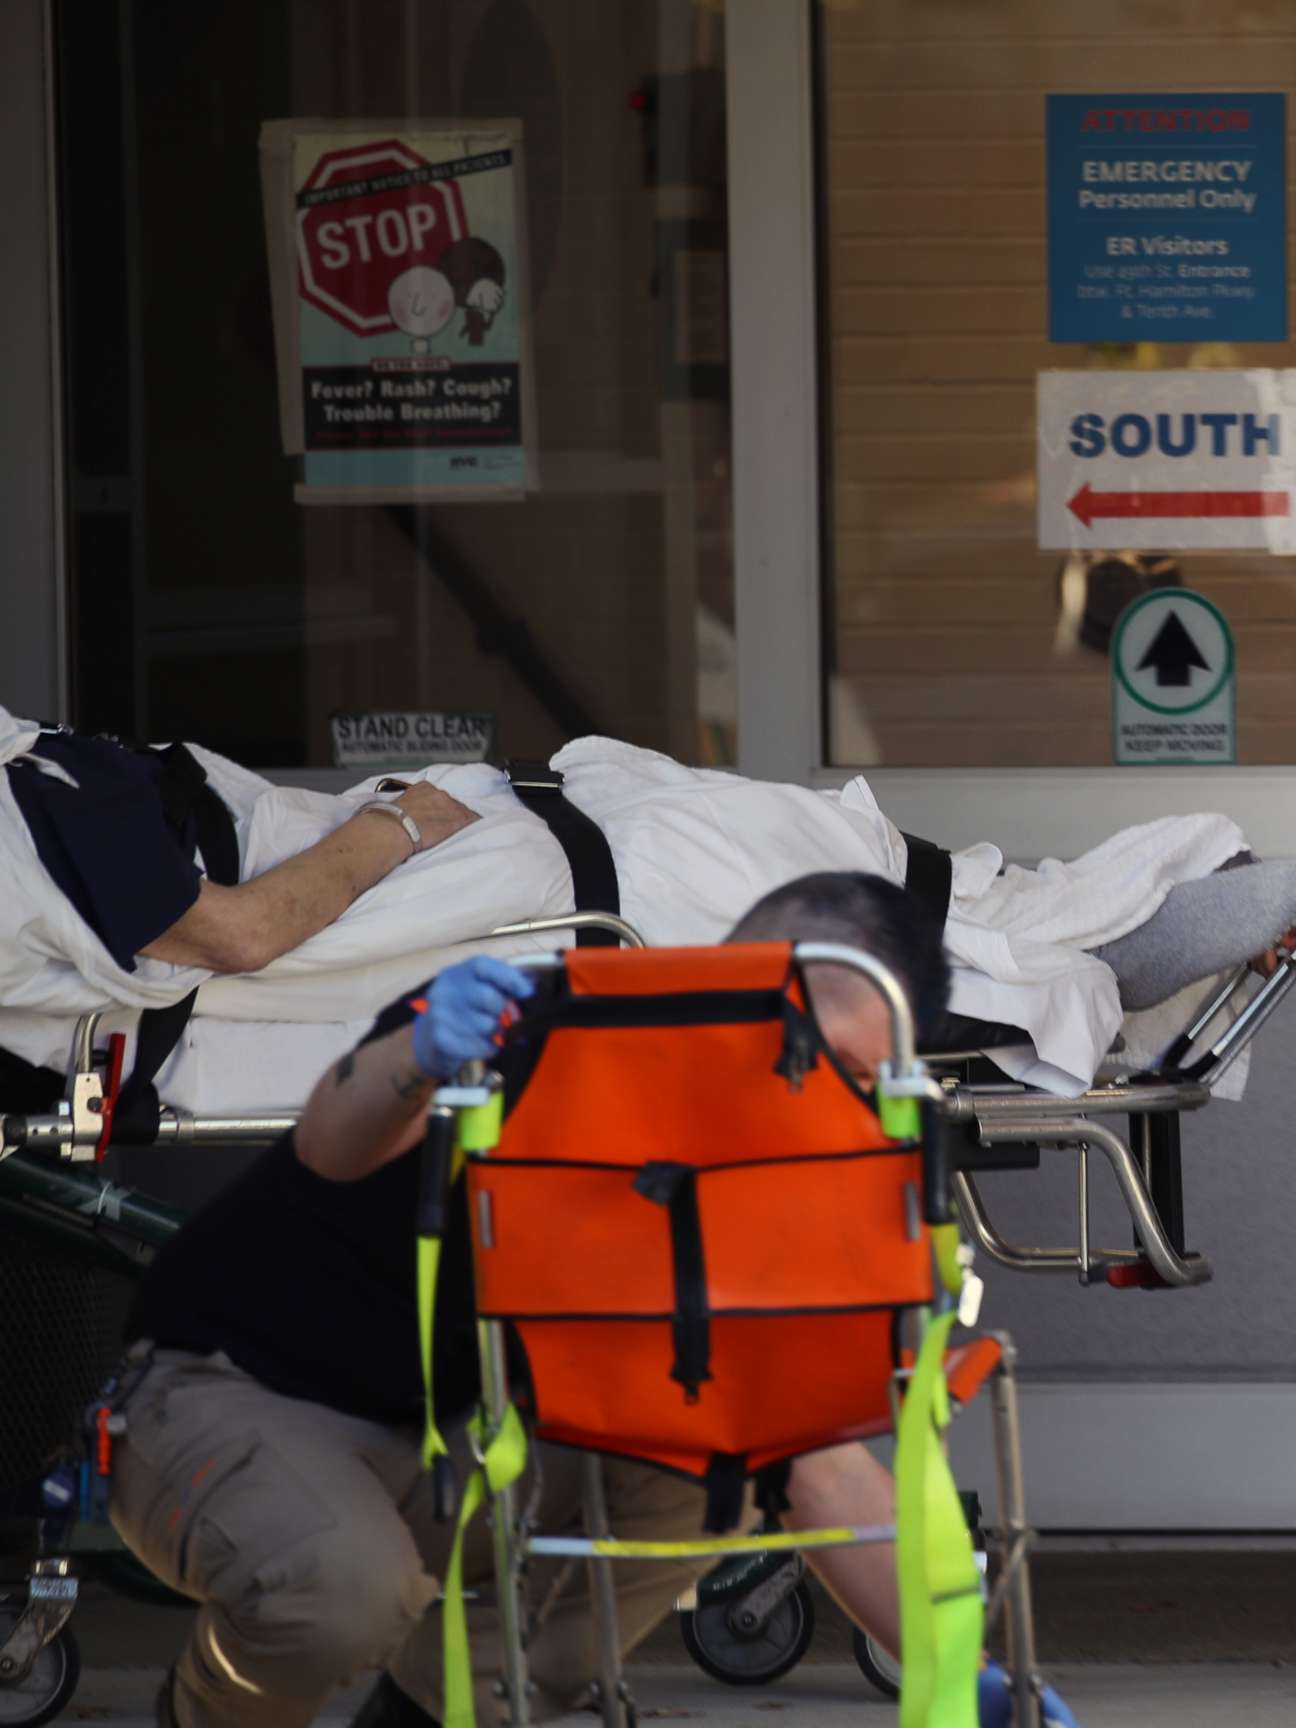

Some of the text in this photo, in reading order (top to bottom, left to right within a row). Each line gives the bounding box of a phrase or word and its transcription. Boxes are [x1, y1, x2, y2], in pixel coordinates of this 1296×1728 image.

[1083, 109, 1250, 132] ATTENTION
[1082, 160, 1253, 183] EMERGENCY
[1078, 188, 1257, 214] Personnel Only
[317, 204, 437, 270] STOP
[1105, 234, 1230, 256] ER Visitors
[311, 377, 513, 400] Fever? Rash? Cough?
[323, 401, 501, 423] Trouble Breathing?
[1069, 412, 1281, 458] SOUTH
[338, 715, 485, 739] STAND CLEAR
